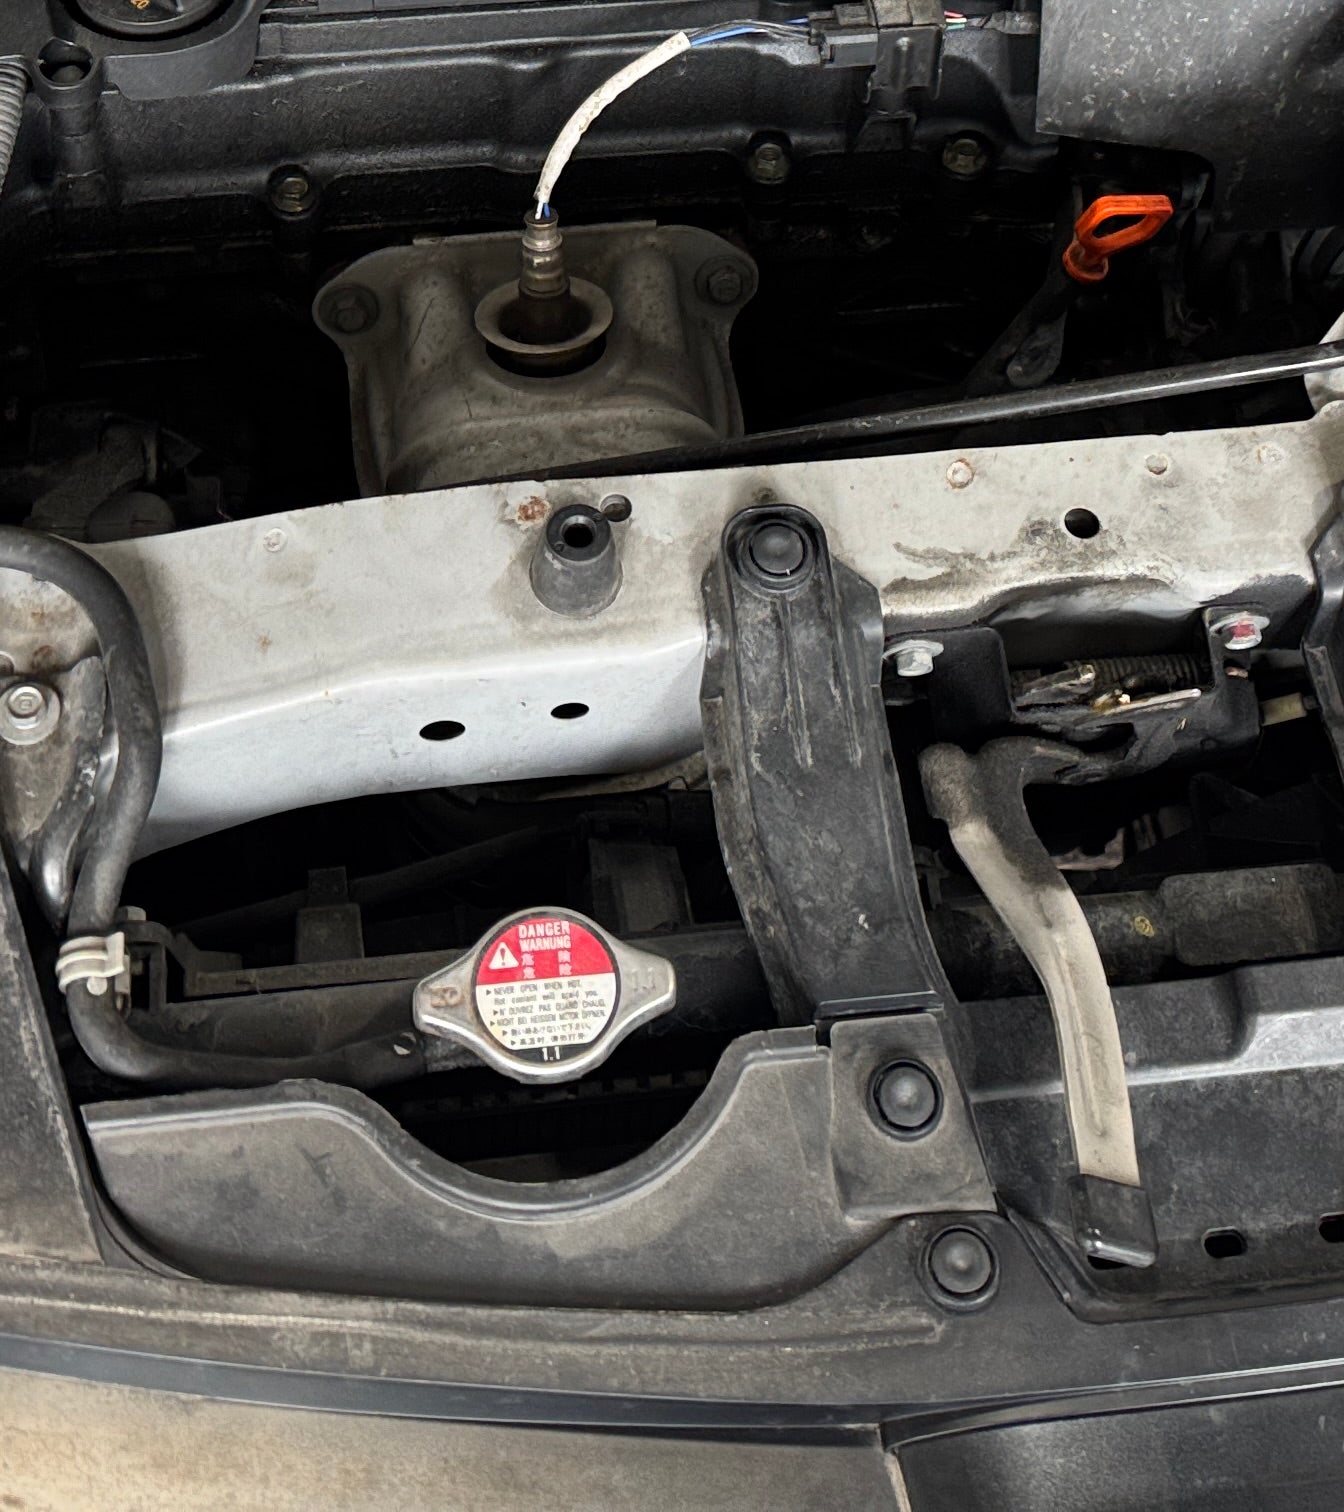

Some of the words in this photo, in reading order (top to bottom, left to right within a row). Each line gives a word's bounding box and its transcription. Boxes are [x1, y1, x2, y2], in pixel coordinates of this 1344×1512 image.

[518, 920, 571, 939] DANGER
[519, 934, 572, 953] WARNUNG
[520, 983, 538, 994] OPEN
[541, 1045, 561, 1062] 1.1
